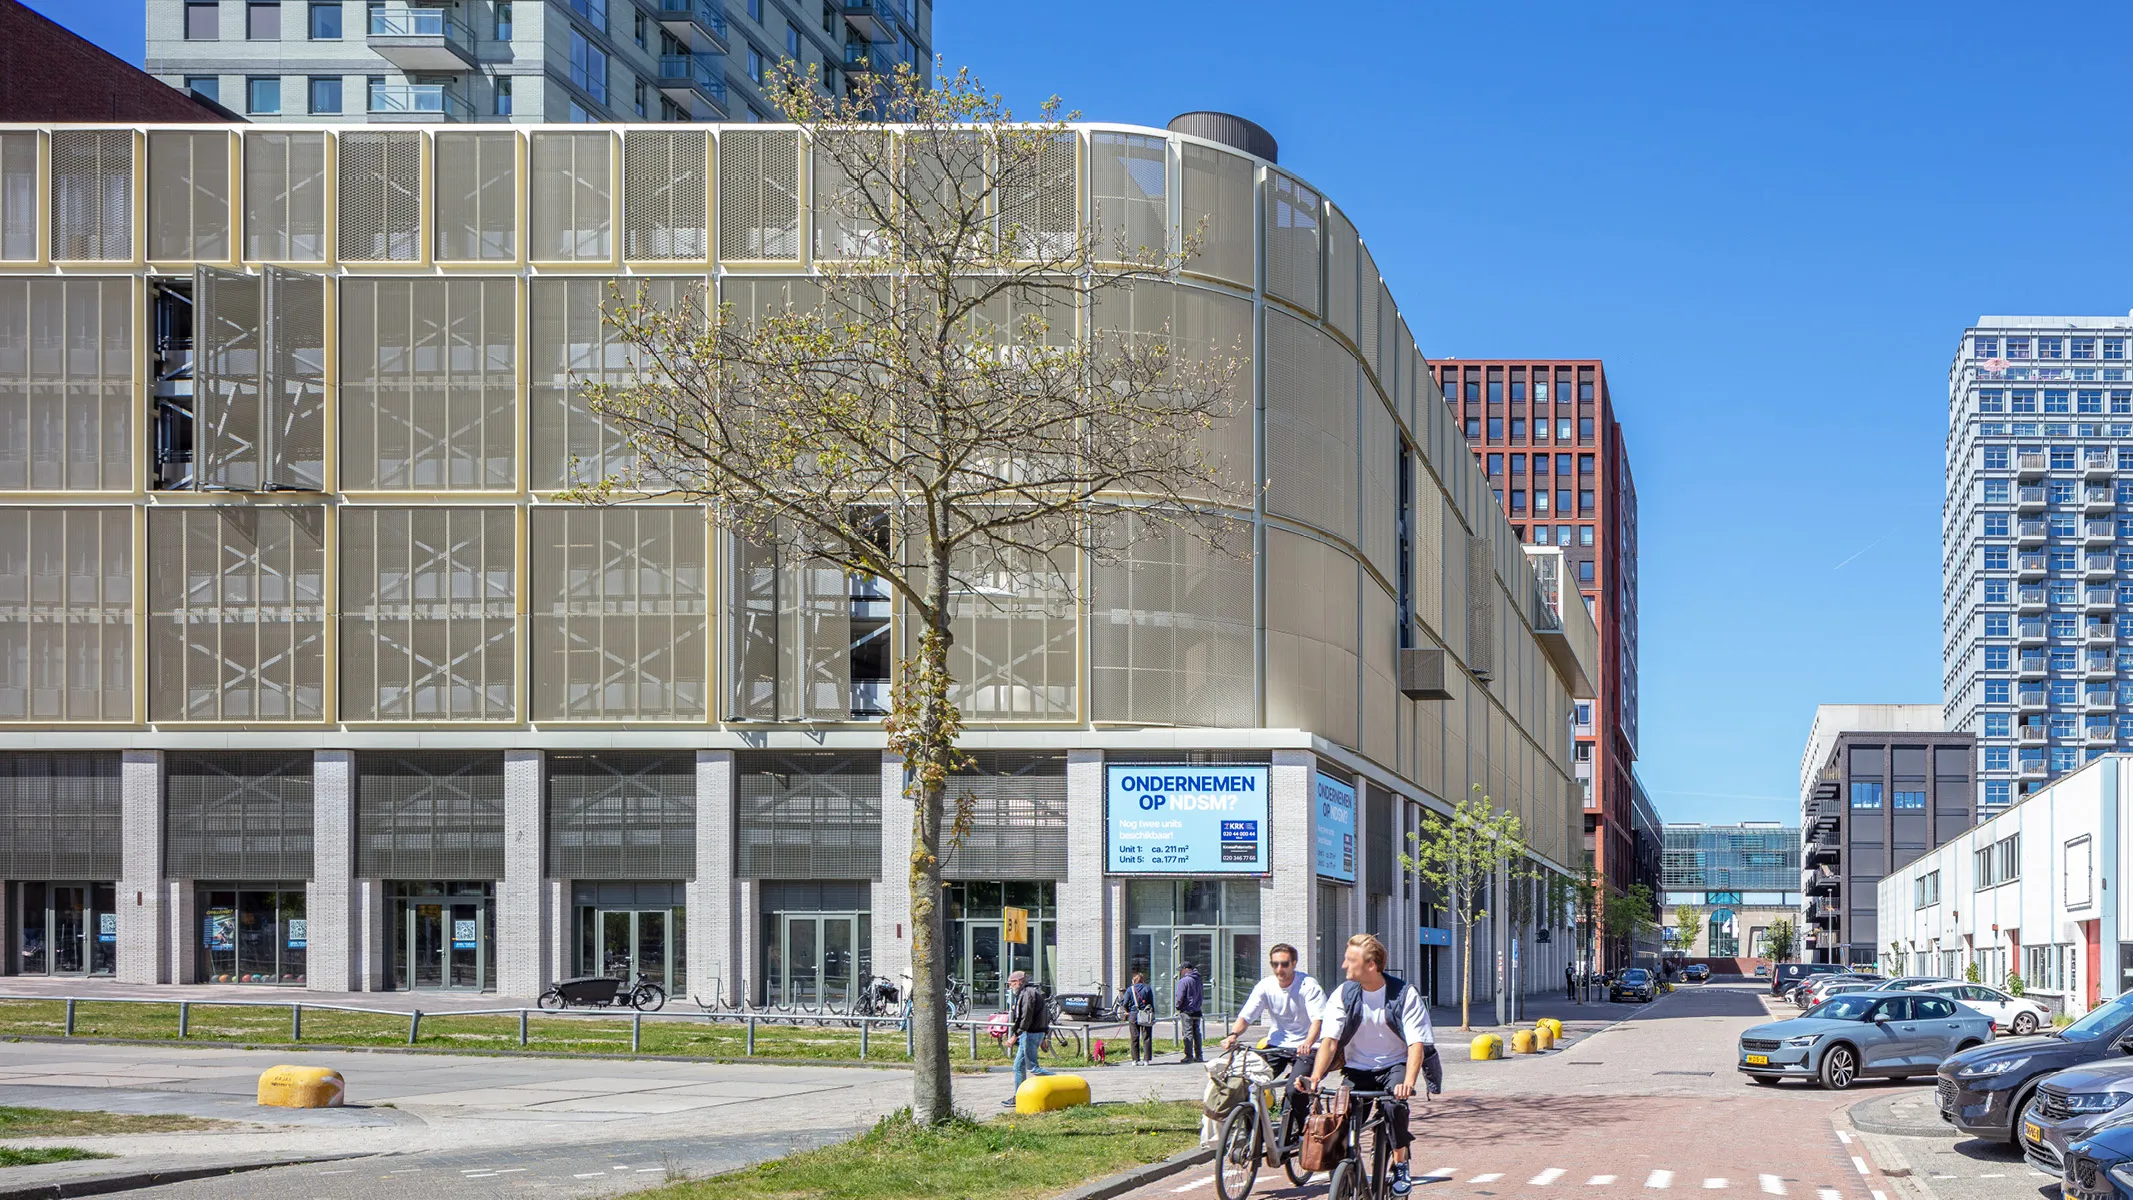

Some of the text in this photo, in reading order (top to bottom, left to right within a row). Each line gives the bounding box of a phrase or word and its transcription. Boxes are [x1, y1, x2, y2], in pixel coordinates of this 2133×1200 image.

[1121, 776, 1255, 792] ONDERNEMEN
[1318, 782, 1352, 809] ONDERNEMEN
[1139, 794, 1238, 811] OP NDSM?
[1323, 802, 1331, 818] OP
[1119, 819, 1182, 830] Nog twee units
[1229, 822, 1245, 830] KRK
[1119, 831, 1174, 840] beschikbaar!
[1119, 845, 1136, 853] Unit
[1137, 845, 1143, 853] 1:
[1164, 845, 1177, 853] 211
[1119, 855, 1136, 864] Unit
[1137, 855, 1145, 864] 5:
[1151, 856, 1164, 864] ca.
[1164, 855, 1177, 864] 177
